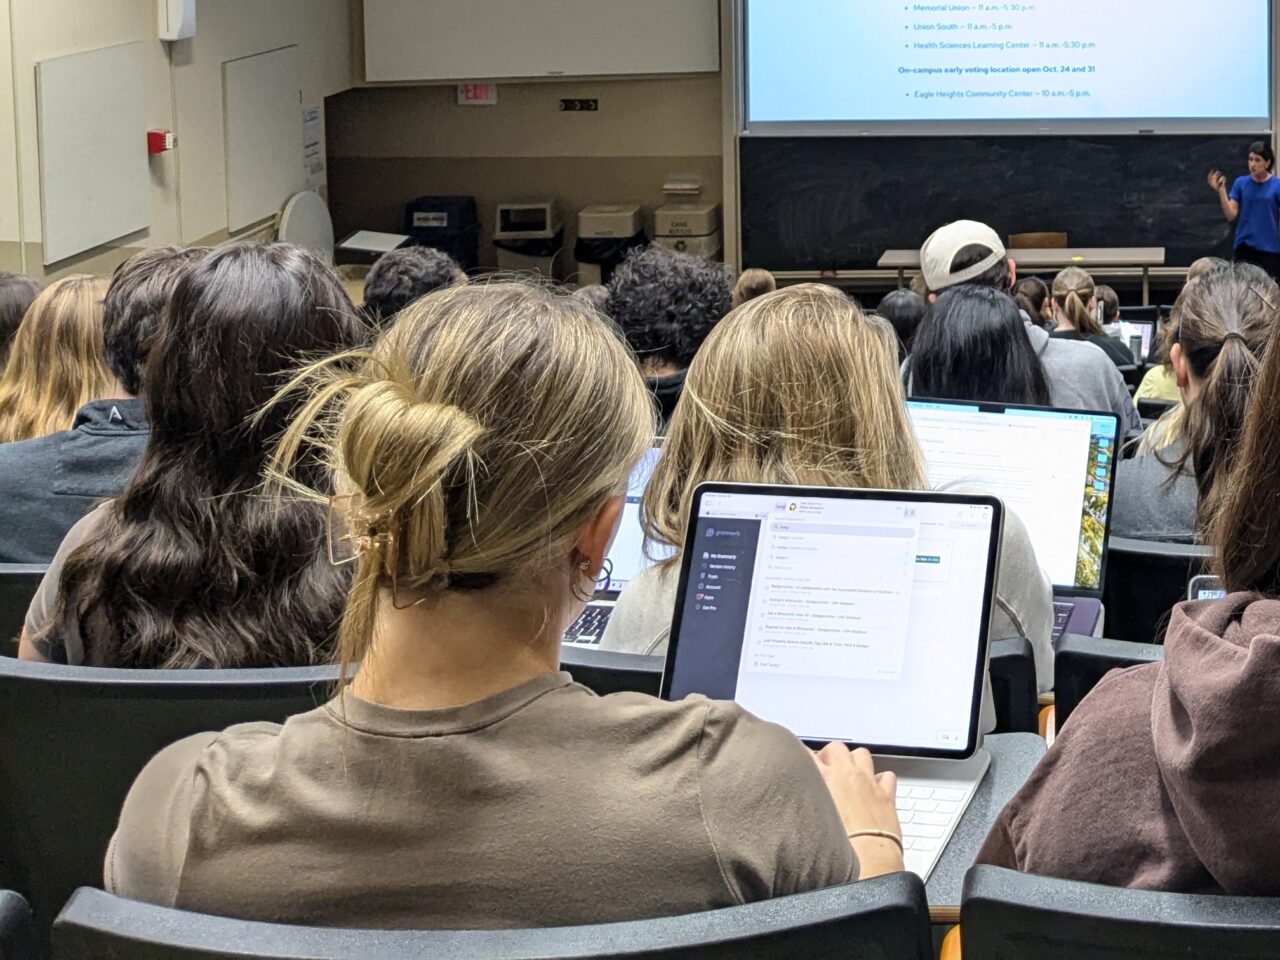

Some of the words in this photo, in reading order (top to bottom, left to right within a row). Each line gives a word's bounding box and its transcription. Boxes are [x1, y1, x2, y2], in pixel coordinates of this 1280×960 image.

[913, 4, 947, 12] Memorial
[948, 4, 970, 12] Union
[913, 23, 935, 31] Union
[936, 23, 958, 31] South
[913, 41, 938, 50] Health
[939, 41, 971, 49] Sciences
[972, 41, 1004, 51] Learning
[1005, 41, 1030, 49] Center
[897, 66, 943, 75] On-campus
[944, 66, 963, 75] early
[964, 66, 989, 75] voting
[990, 66, 1021, 74] location
[1022, 67, 1041, 75] open
[1042, 65, 1058, 73] Oct.
[1060, 65, 1070, 73] 24
[1071, 65, 1086, 73] and
[1087, 65, 1096, 73] 31
[914, 91, 934, 99] Eagle
[936, 91, 964, 99] Heights
[965, 90, 1007, 99] Community
[1008, 90, 1033, 98] Center
[1042, 90, 1050, 98] 10
